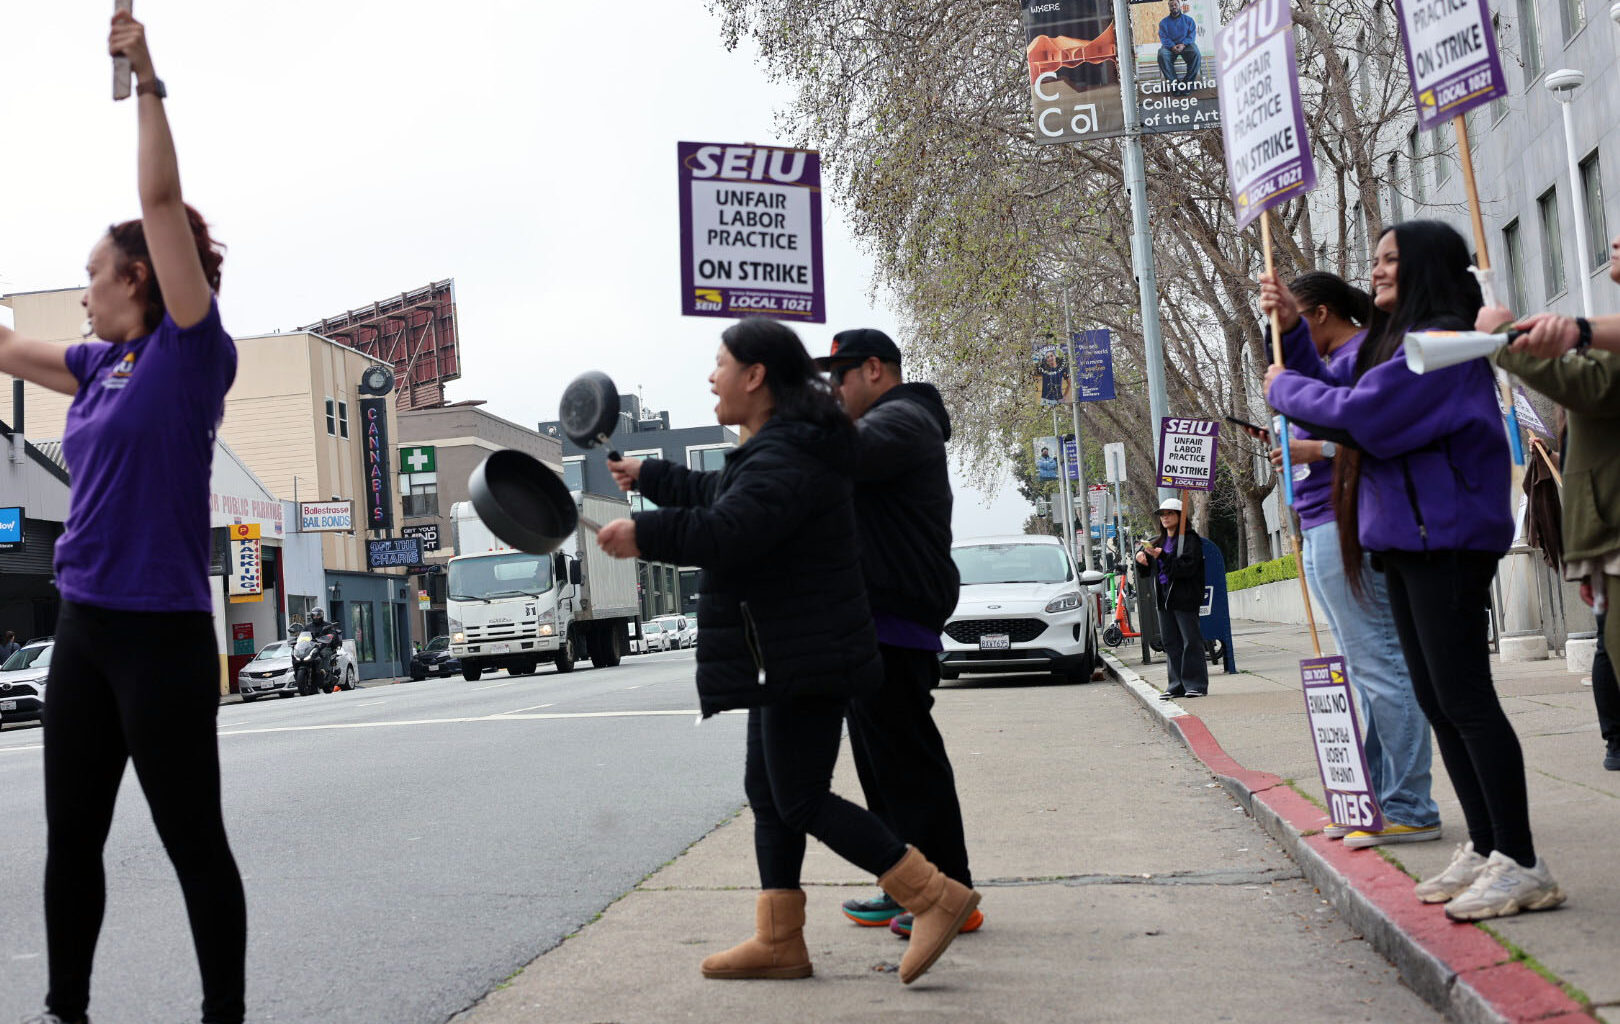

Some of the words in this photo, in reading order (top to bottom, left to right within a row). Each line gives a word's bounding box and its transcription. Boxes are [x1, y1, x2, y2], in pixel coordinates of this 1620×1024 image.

[1222, 0, 1280, 70] SEIU
[1436, 24, 1482, 69] STRIKE
[1233, 51, 1272, 92] UNFAIR
[1416, 48, 1435, 79] ON
[1141, 77, 1217, 95] California
[1236, 75, 1273, 115] LABOR
[1437, 81, 1468, 106] LOCAL
[1143, 97, 1198, 111] College
[1144, 114, 1161, 127] of
[1164, 113, 1191, 125] the
[1193, 109, 1222, 124] Art
[1233, 94, 1283, 142] PRACTICE
[1251, 126, 1295, 171] STRIKE
[692, 146, 807, 183] SEIU
[1235, 156, 1250, 183] ON
[1278, 167, 1303, 190] 1021
[716, 190, 787, 209] UNFAIR
[719, 210, 786, 229] LABOR
[708, 230, 798, 250] PRACTICE
[699, 259, 732, 280] ON
[739, 261, 808, 284] STRIKE
[695, 302, 722, 311] SEIU
[729, 296, 779, 309] LOCAL
[782, 299, 813, 311] 1021
[1166, 418, 1213, 435] SEIU
[1174, 436, 1203, 446] UNFAIR
[1174, 446, 1202, 454] LABOR
[367, 407, 384, 522] CANNABIS
[1169, 453, 1206, 462] PRACTICE
[1164, 464, 1178, 474] ON
[1180, 466, 1209, 476] STRIKE
[223, 495, 249, 516] PUBLIC
[252, 500, 283, 520] PARKING
[303, 516, 320, 528] BAIL
[322, 516, 350, 527] BONDS
[395, 539, 417, 551] THE
[1309, 695, 1332, 714] STRIKE
[1333, 694, 1347, 713] ON
[1332, 794, 1374, 826] SEIU
